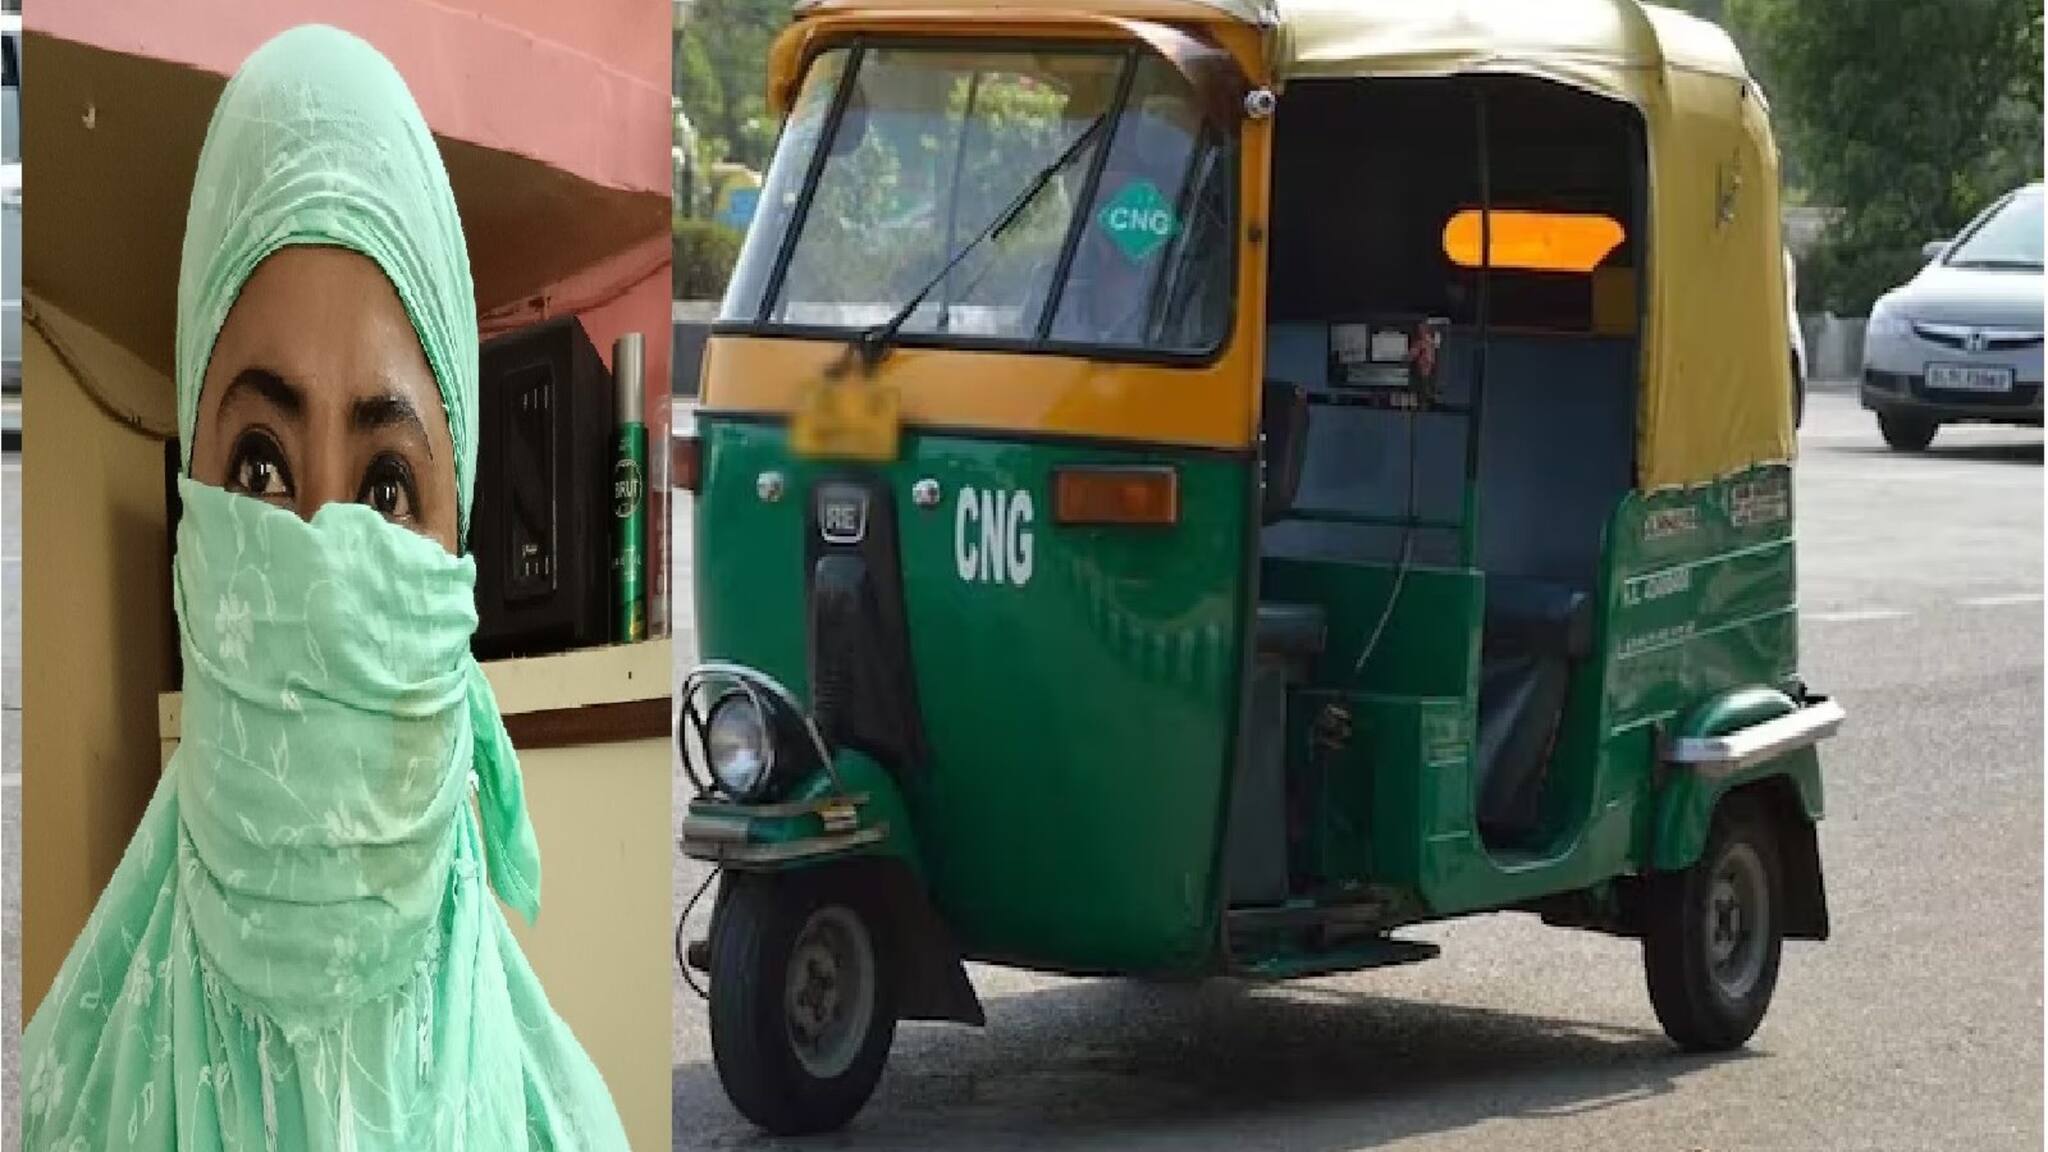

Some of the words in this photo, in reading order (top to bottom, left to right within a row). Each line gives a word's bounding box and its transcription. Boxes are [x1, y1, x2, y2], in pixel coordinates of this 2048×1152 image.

[1109, 208, 1168, 235] CNG
[615, 479, 639, 499] BRUT
[826, 503, 858, 531] RE
[955, 486, 1034, 586] CNG
